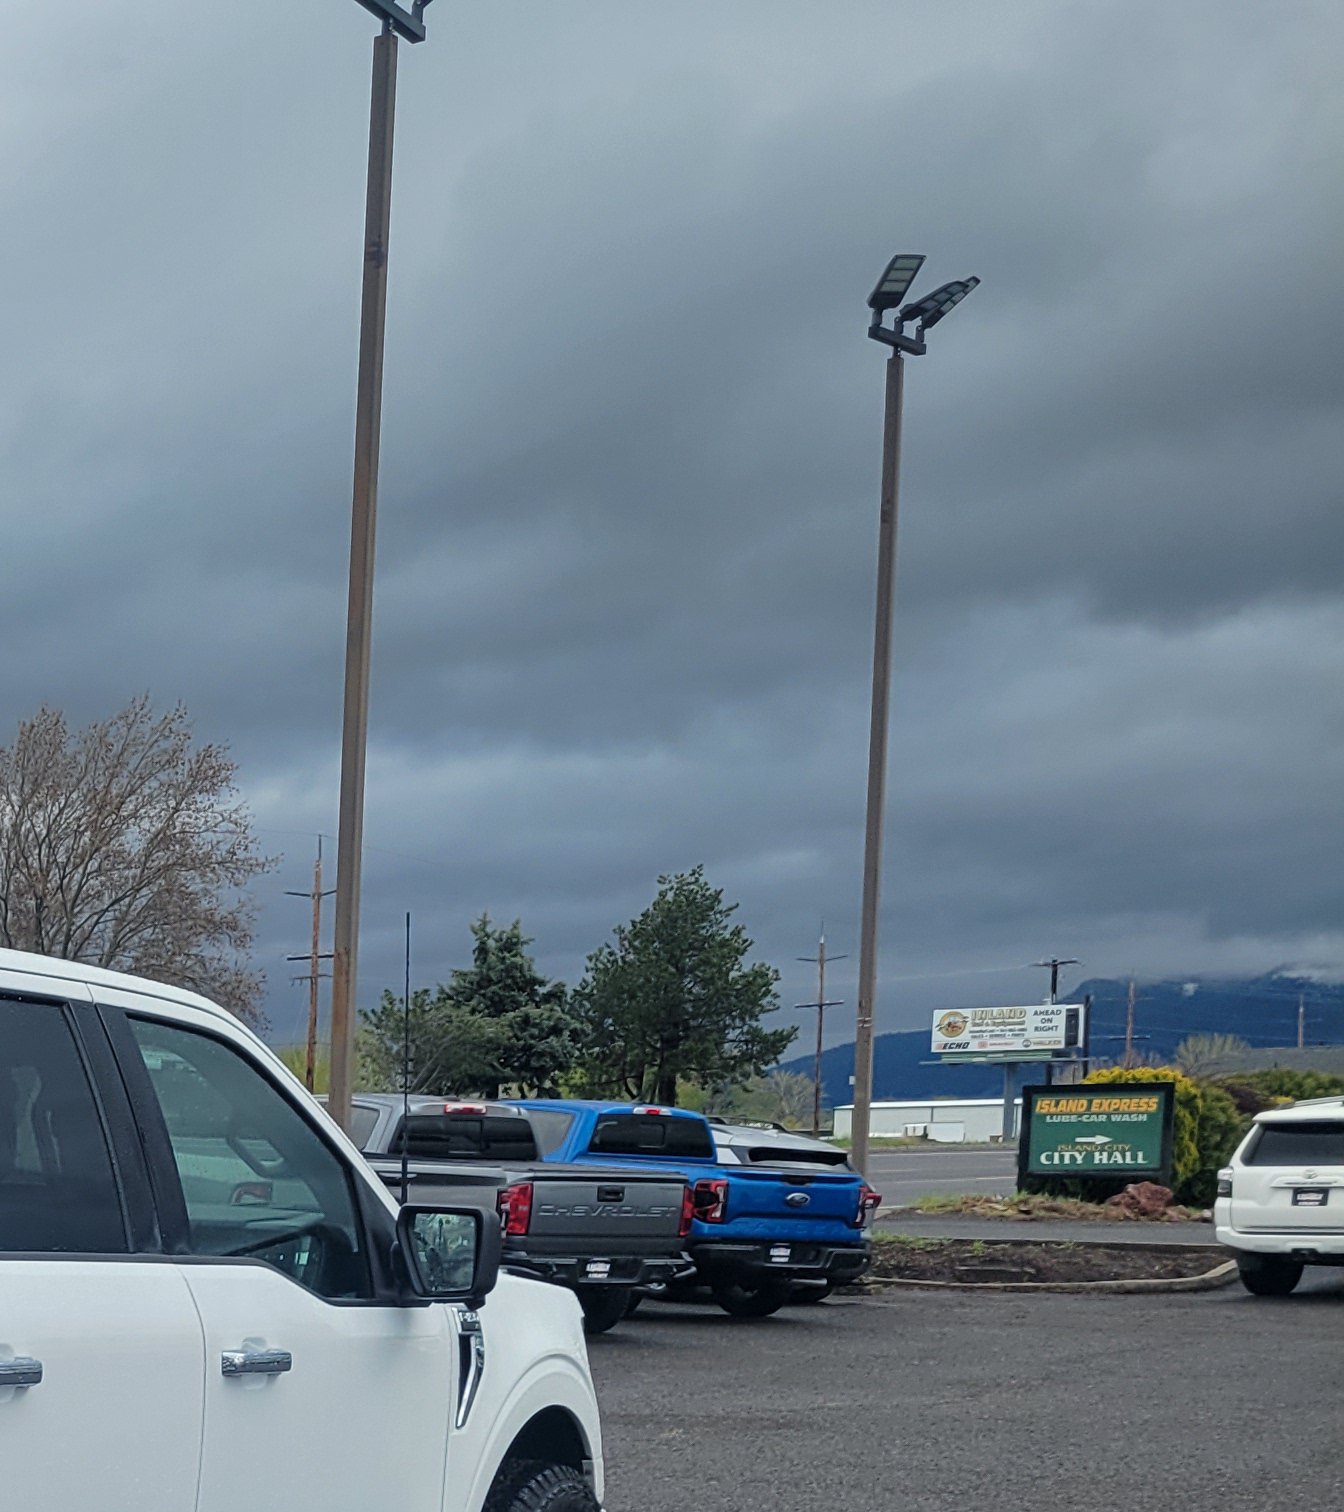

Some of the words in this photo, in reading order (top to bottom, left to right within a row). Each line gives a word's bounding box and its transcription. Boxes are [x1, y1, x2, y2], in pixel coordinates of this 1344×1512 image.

[971, 1008, 1027, 1021] INLAND
[1034, 1025, 1059, 1033] RIGHT
[943, 1042, 971, 1050] ECHO
[1035, 1098, 1088, 1114] ISLAND
[1090, 1096, 1159, 1113] EXPRESS
[1110, 1113, 1148, 1122] WASH
[1057, 1144, 1102, 1152] ISLAND
[1039, 1151, 1087, 1165] CITY
[1093, 1151, 1149, 1165] HALL
[538, 1203, 678, 1219] CHEVROLET
